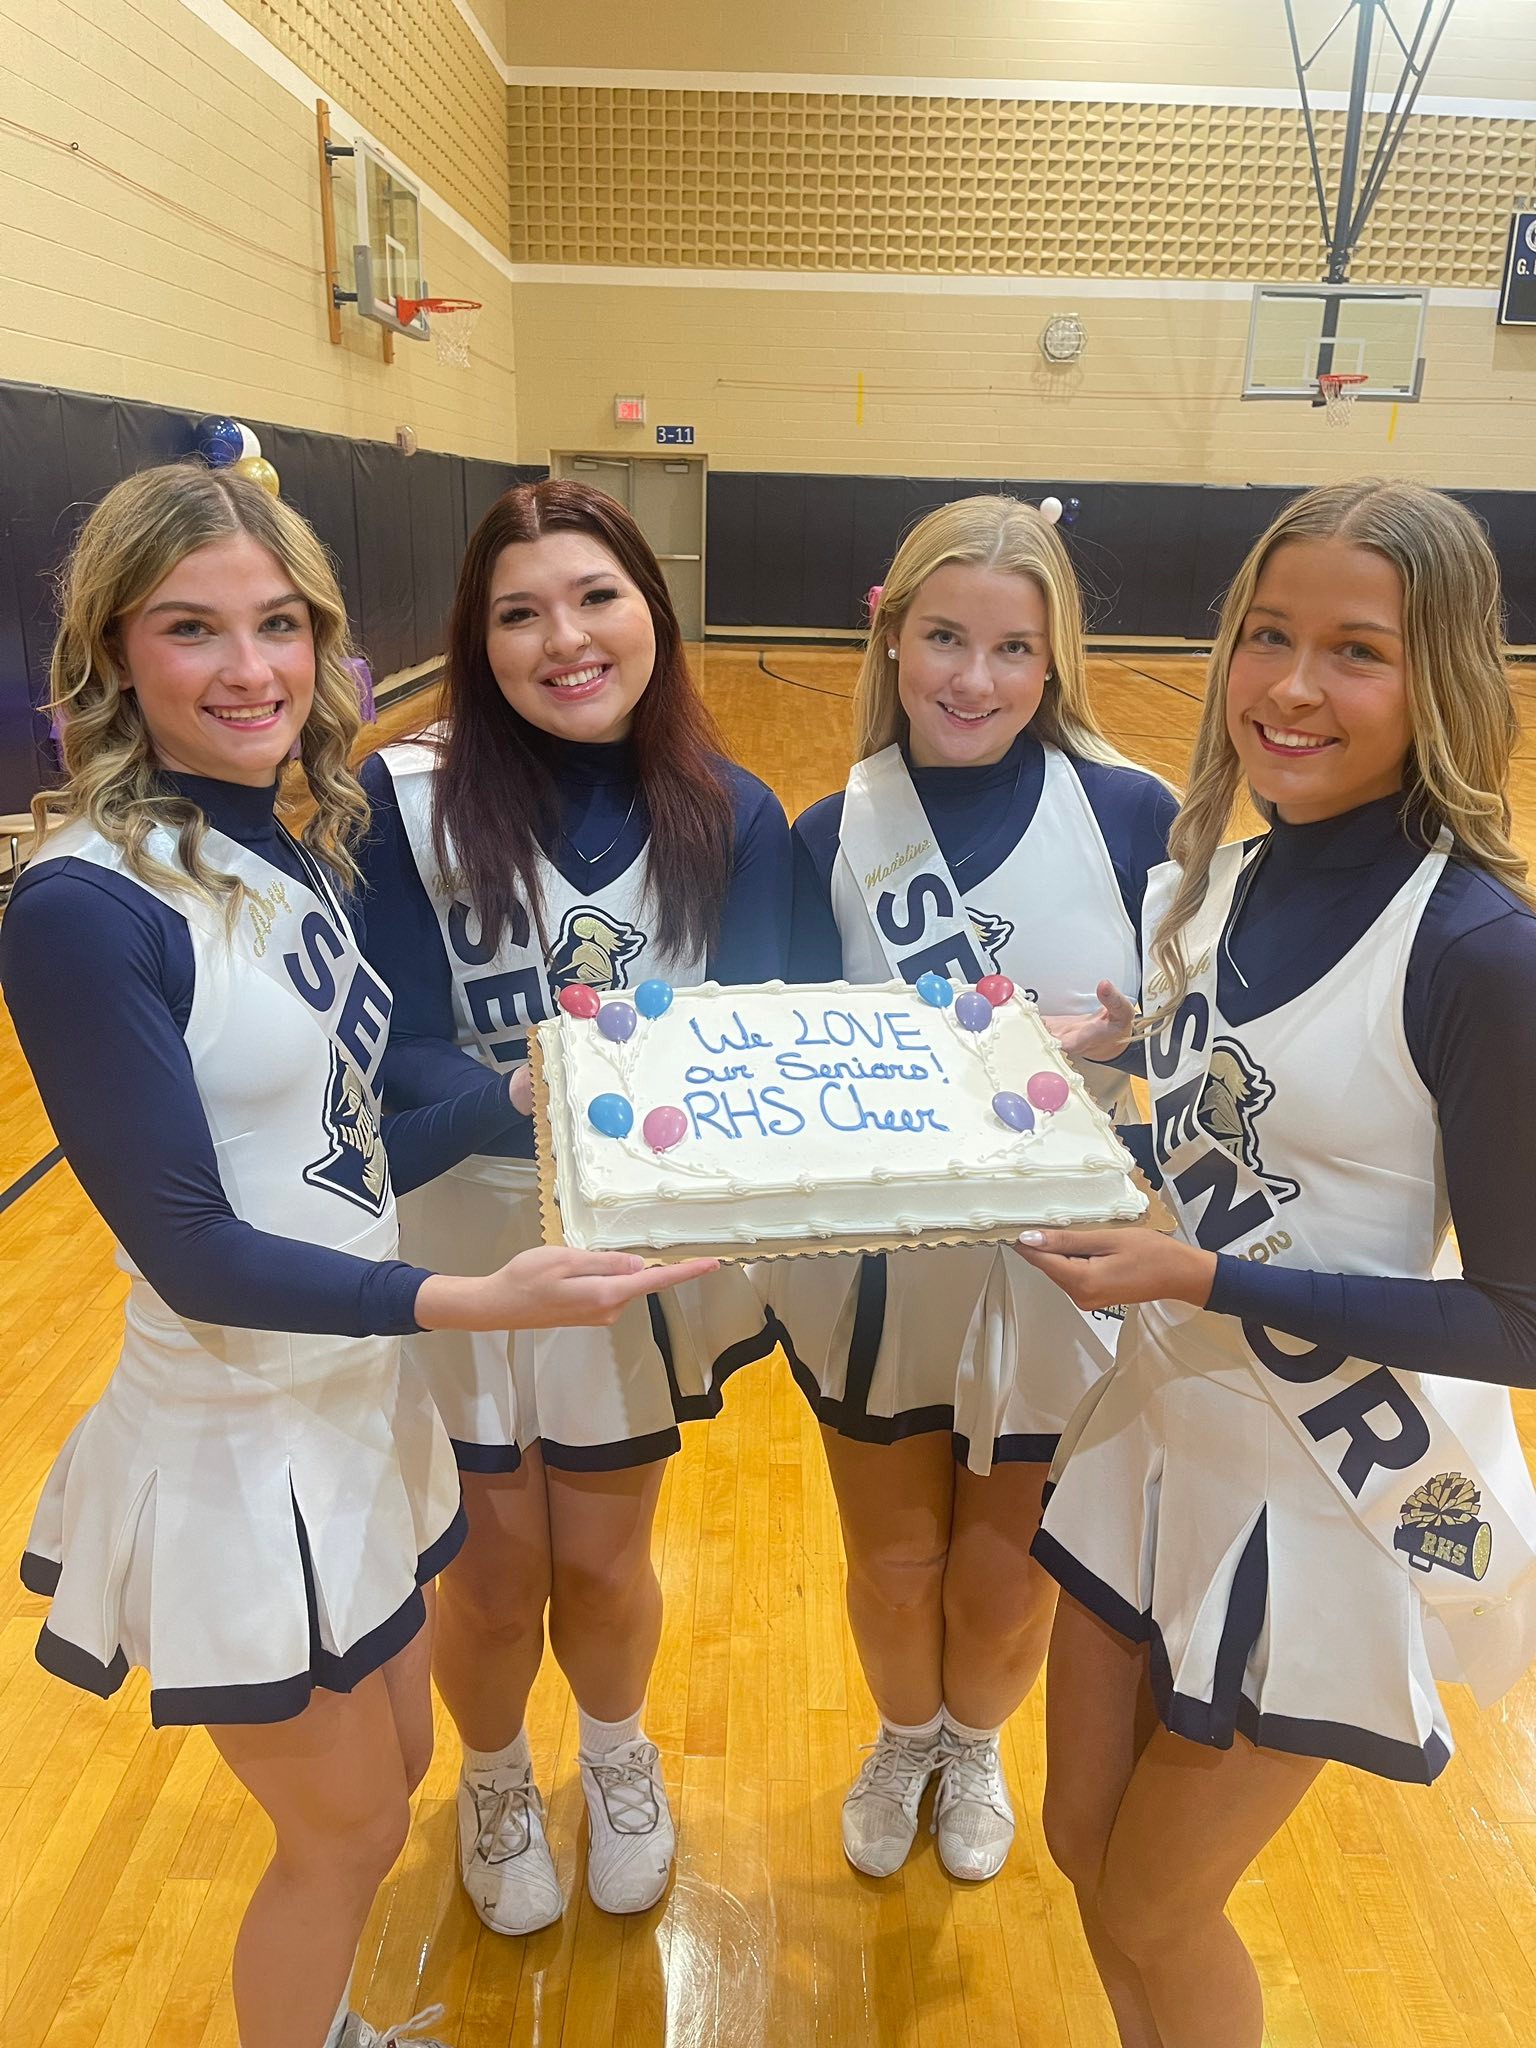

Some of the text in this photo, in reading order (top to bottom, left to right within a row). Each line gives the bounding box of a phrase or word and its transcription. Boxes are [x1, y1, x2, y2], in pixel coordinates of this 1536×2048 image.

[657, 427, 694, 443] 3-11
[689, 1010, 931, 1054] We LOVE
[685, 1052, 950, 1084] our Seniors!
[683, 1081, 951, 1140] RHS Cheer
[1420, 1531, 1468, 1566] RHS
